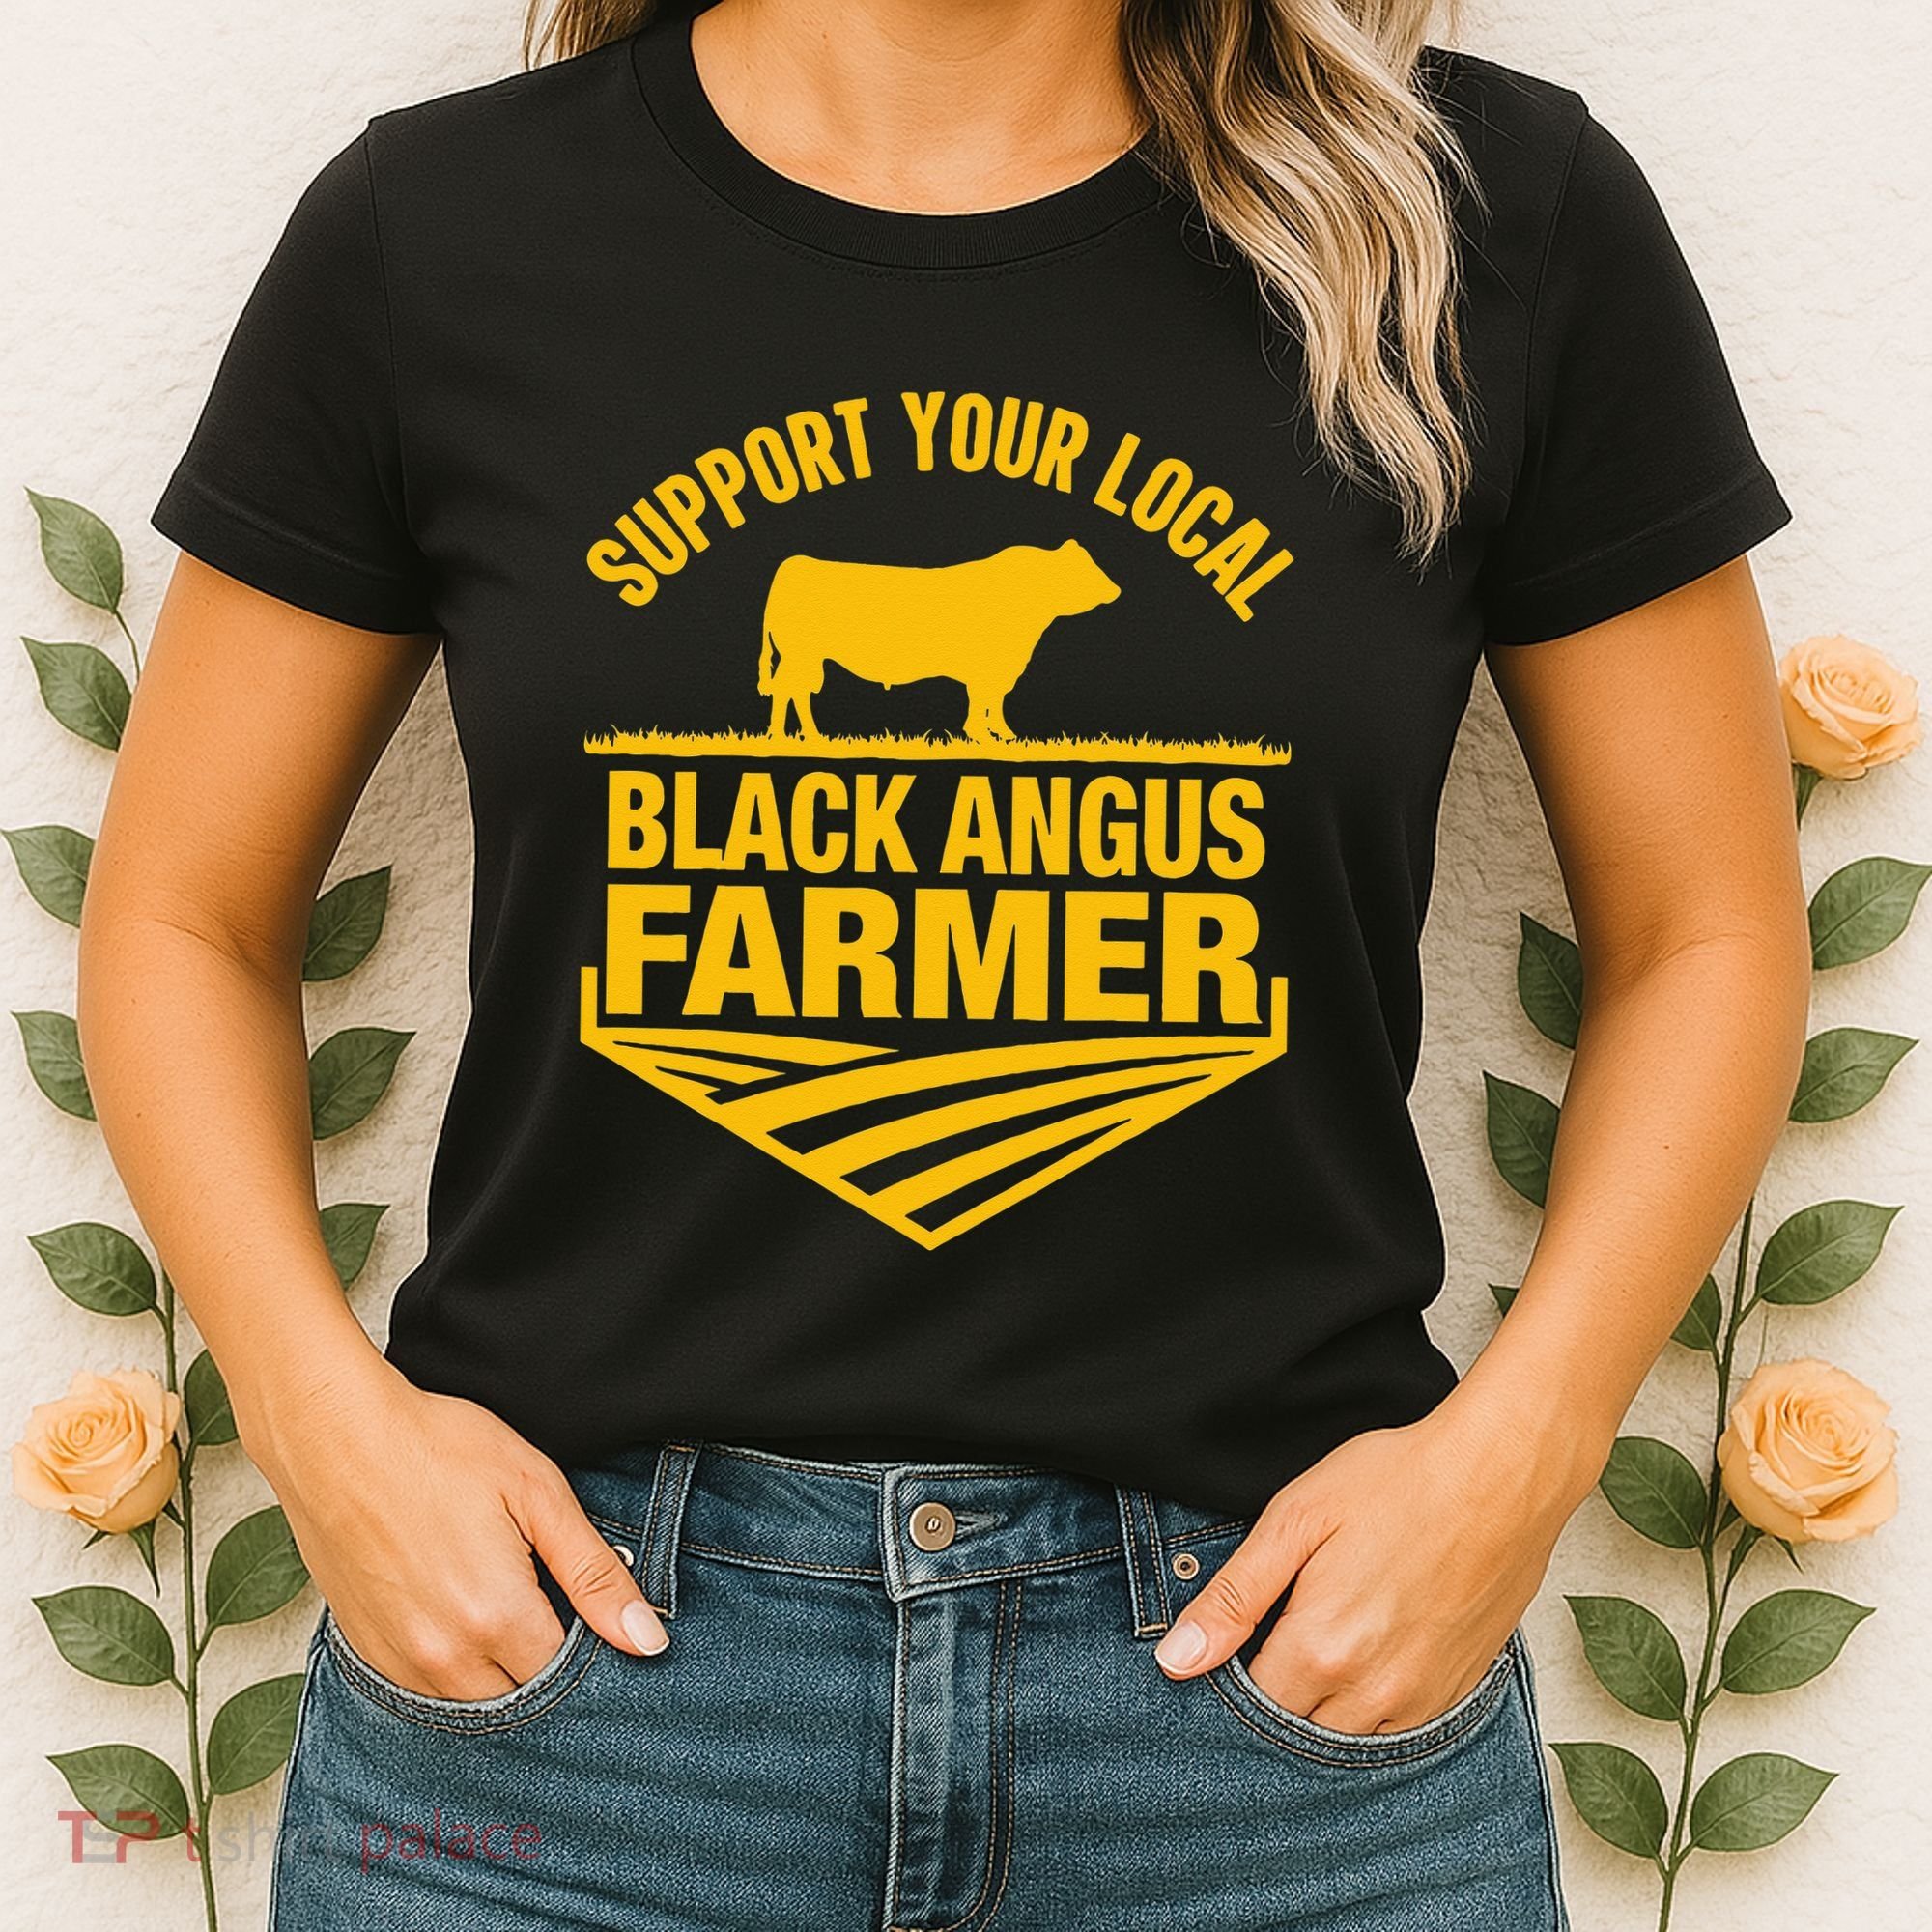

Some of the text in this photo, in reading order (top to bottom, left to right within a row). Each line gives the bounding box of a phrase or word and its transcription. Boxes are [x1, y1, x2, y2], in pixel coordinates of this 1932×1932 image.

[586, 390, 1294, 623] SUPPORT YOUR LOCAL
[606, 770, 1266, 880] BLACK ANGUS
[604, 883, 1263, 1025] FARMER
